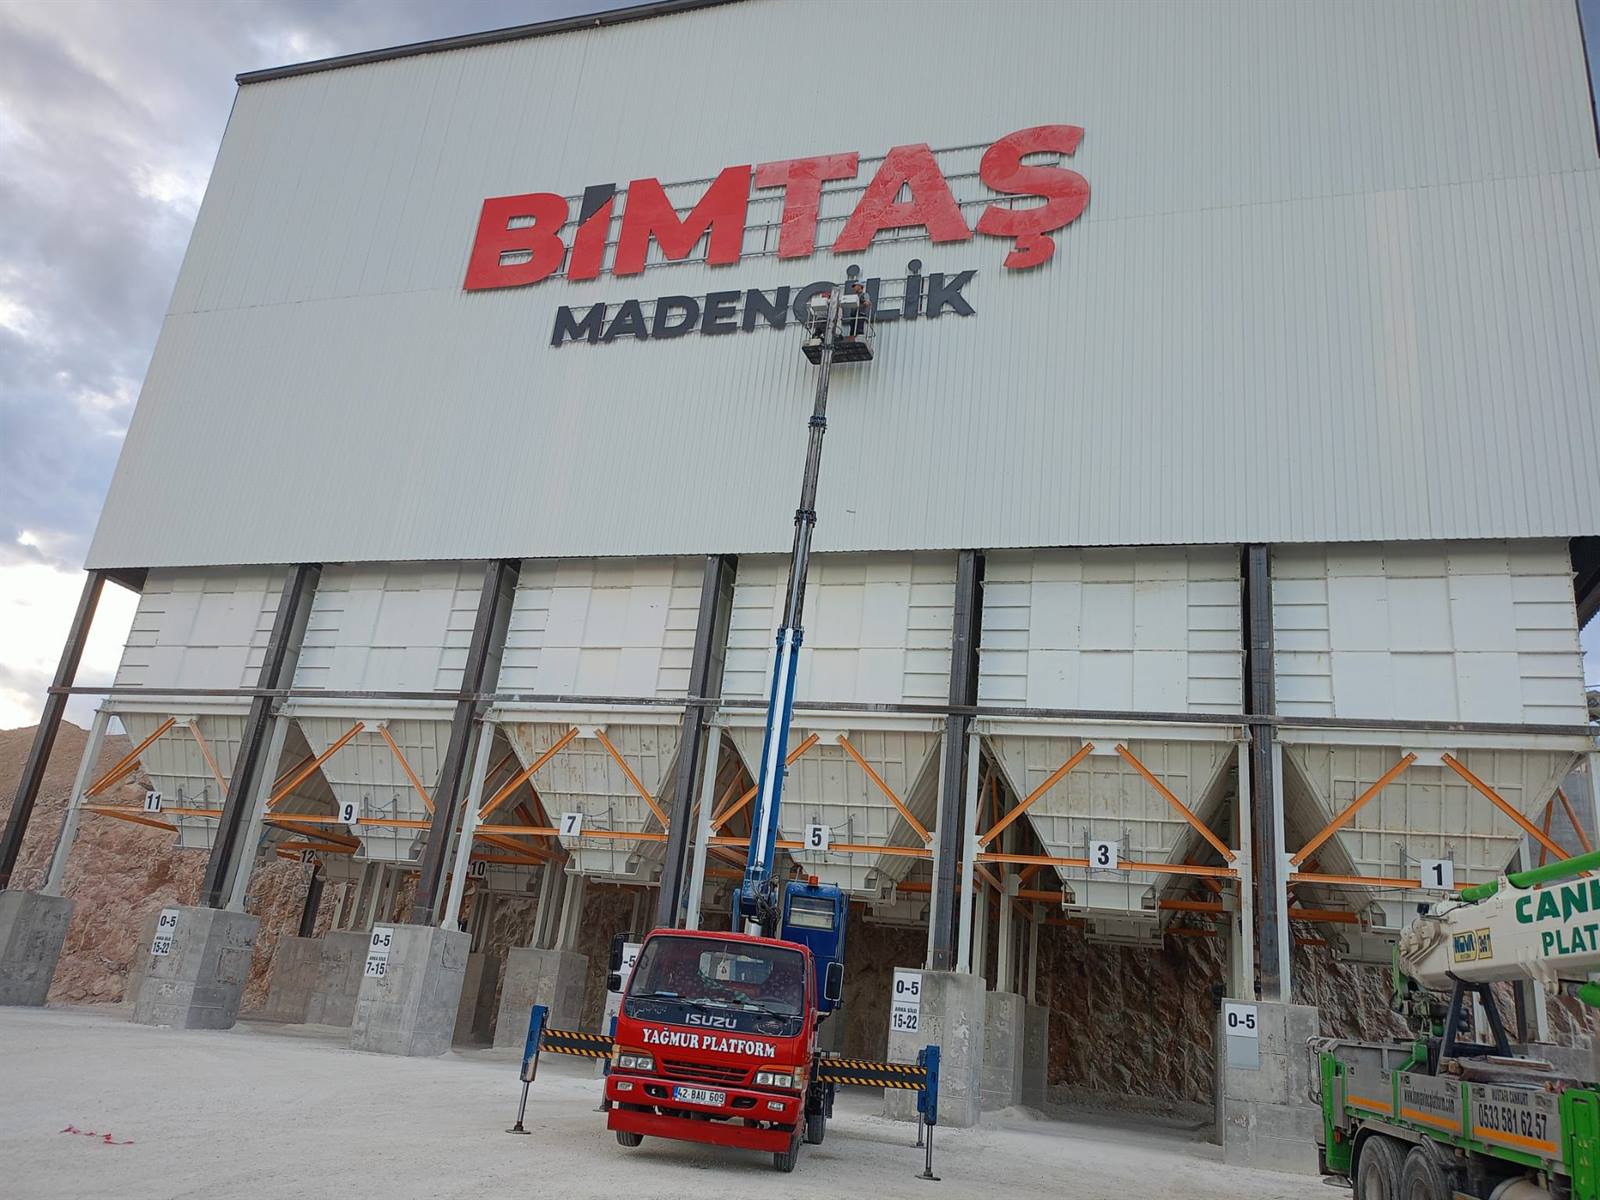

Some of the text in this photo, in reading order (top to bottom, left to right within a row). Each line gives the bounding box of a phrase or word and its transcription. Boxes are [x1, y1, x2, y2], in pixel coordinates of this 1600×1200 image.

[147, 793, 161, 810] 11
[343, 803, 353, 821] 9
[567, 815, 577, 833] 7
[811, 827, 822, 847] 5
[301, 850, 315, 864] 12
[1097, 844, 1110, 866] 3
[471, 861, 486, 876] 10
[1431, 863, 1443, 886] 1
[160, 915, 177, 927] 0-5
[153, 941, 170, 954] 15-22
[372, 933, 391, 947] 0-5
[1541, 923, 1599, 956] PLAT
[366, 961, 385, 975] 7-15
[896, 979, 919, 996] 0-5
[685, 1012, 738, 1029] ISUZU
[893, 1013, 917, 1030] 15-22
[1228, 1012, 1256, 1030] 0-5
[642, 1025, 777, 1058] YAĞMUR PLATFORM
[678, 1087, 725, 1103] 42 BAU 609
[1478, 1103, 1547, 1140] 0533 581 62 57
